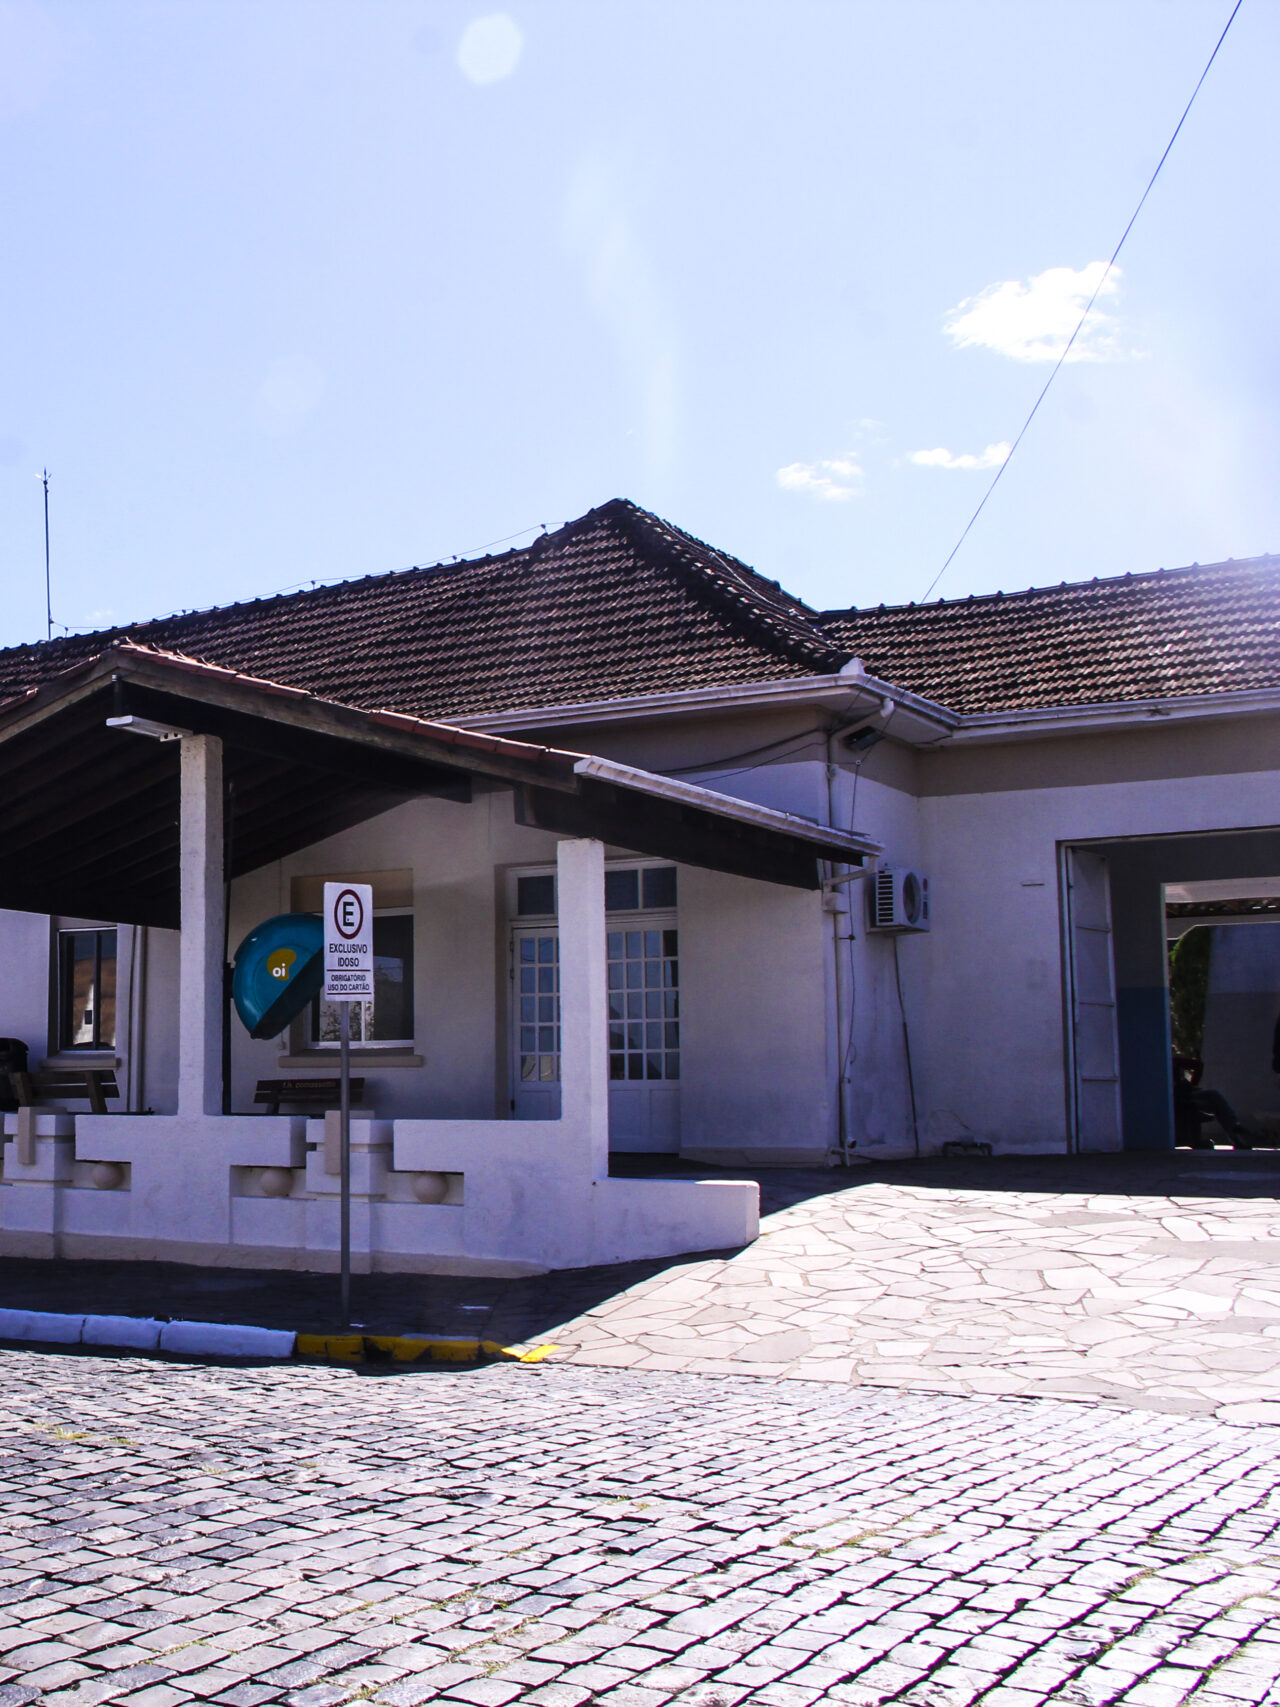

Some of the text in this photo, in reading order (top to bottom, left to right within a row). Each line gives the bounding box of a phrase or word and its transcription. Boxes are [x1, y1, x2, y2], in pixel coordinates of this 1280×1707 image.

[343, 902, 354, 926] E
[329, 943, 368, 954] EXCLUSIVO
[338, 957, 359, 967] IDOSO
[272, 963, 286, 978] oi
[331, 974, 366, 982] OBRIGATÓRIO
[348, 983, 370, 991] CARTÃO
